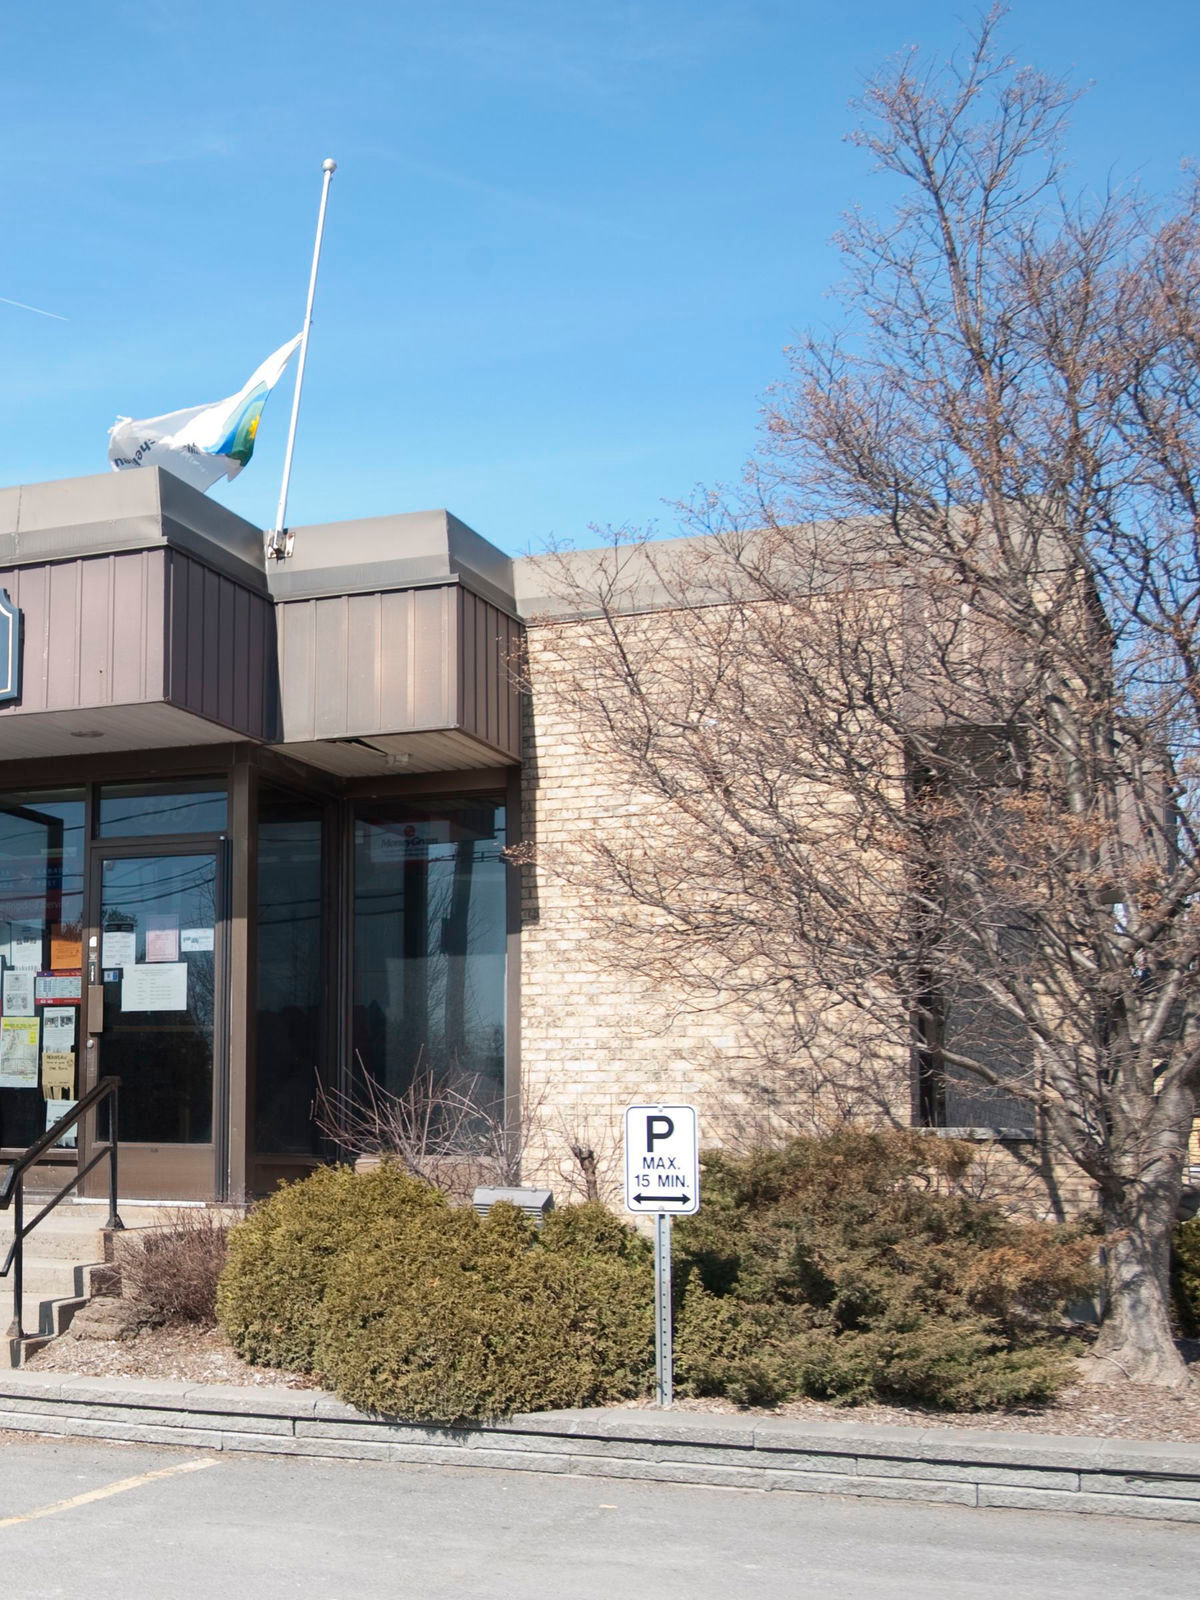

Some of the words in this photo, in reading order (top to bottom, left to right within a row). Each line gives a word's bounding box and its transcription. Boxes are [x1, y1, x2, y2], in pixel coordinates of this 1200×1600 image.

[646, 1115, 675, 1153] P
[642, 1156, 681, 1170] MAX.
[634, 1174, 650, 1187] 15
[657, 1174, 690, 1188] MIN.
